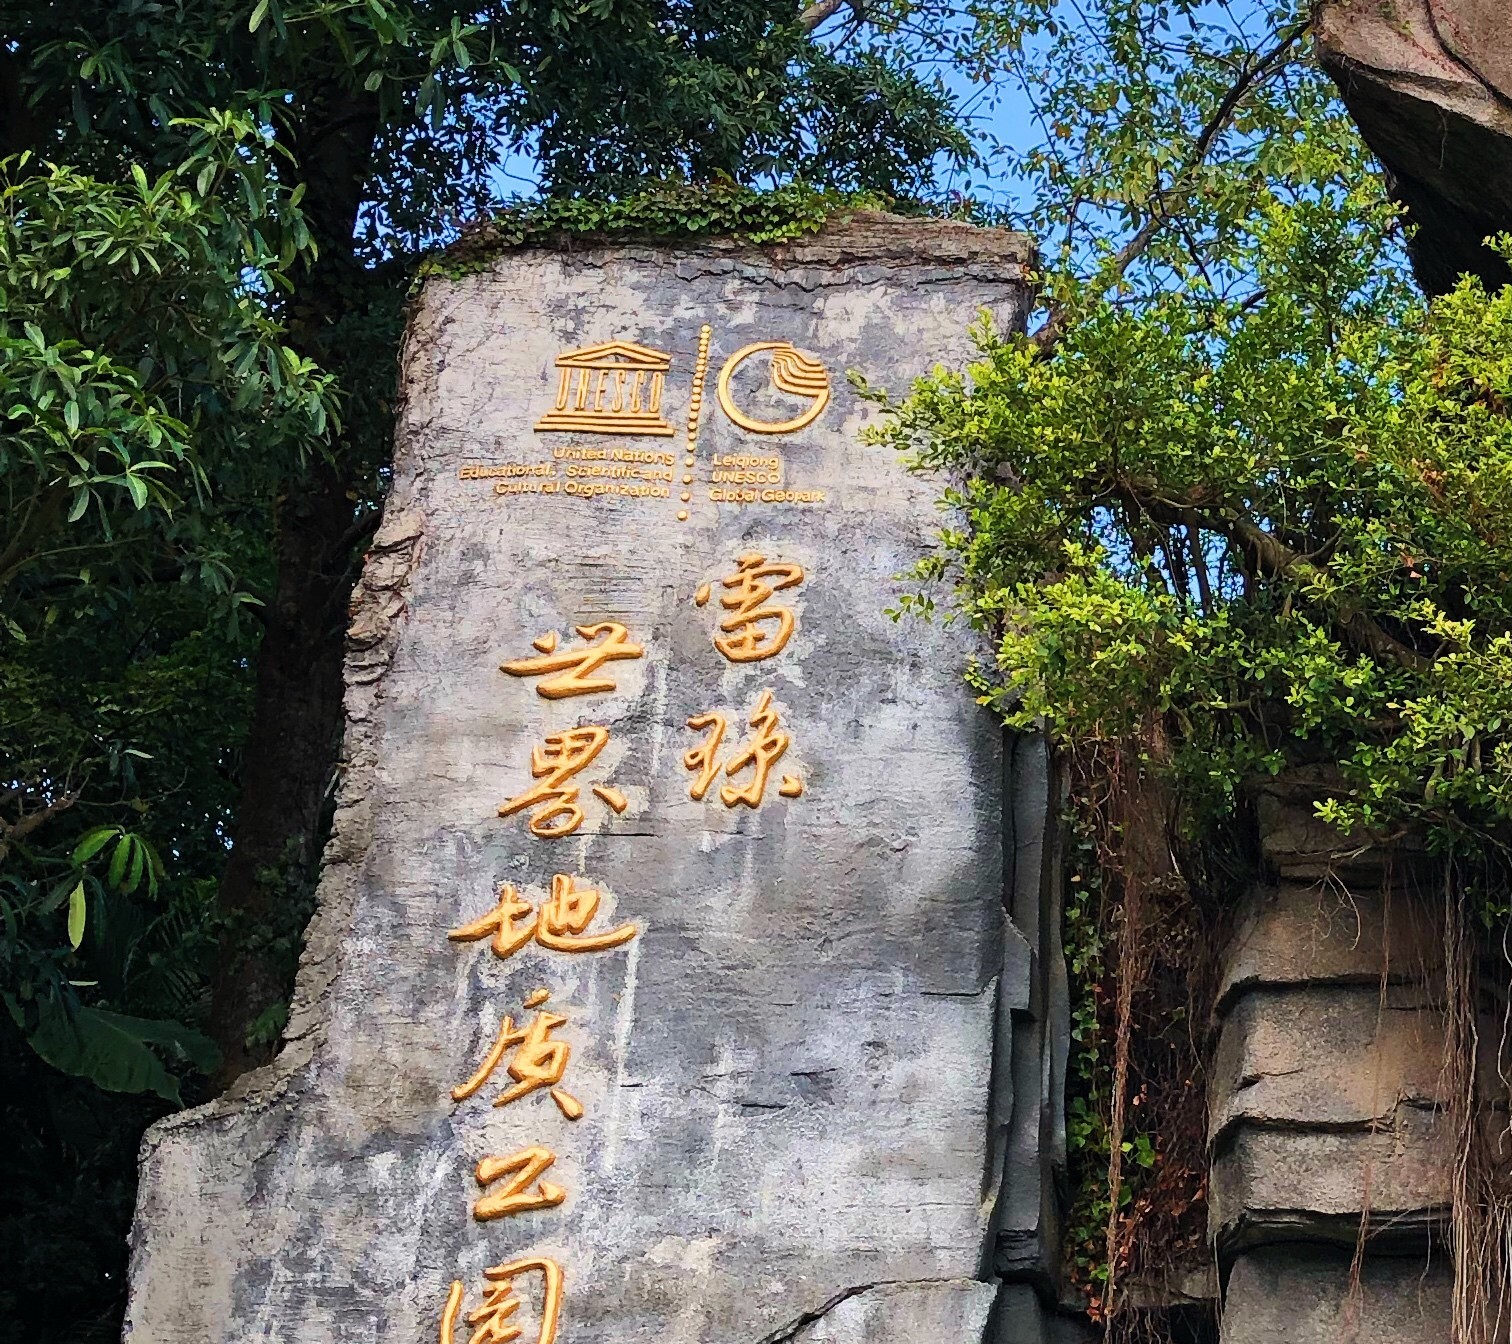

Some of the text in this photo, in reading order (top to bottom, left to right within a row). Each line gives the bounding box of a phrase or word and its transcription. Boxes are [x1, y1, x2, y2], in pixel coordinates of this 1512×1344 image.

[555, 367, 665, 413] UNESCO
[553, 446, 675, 466] United Nations
[713, 453, 779, 471] Leiqiong
[712, 470, 781, 484] UNESCO
[496, 480, 670, 498] Cultural Organization
[709, 488, 826, 505] Global Geopark
